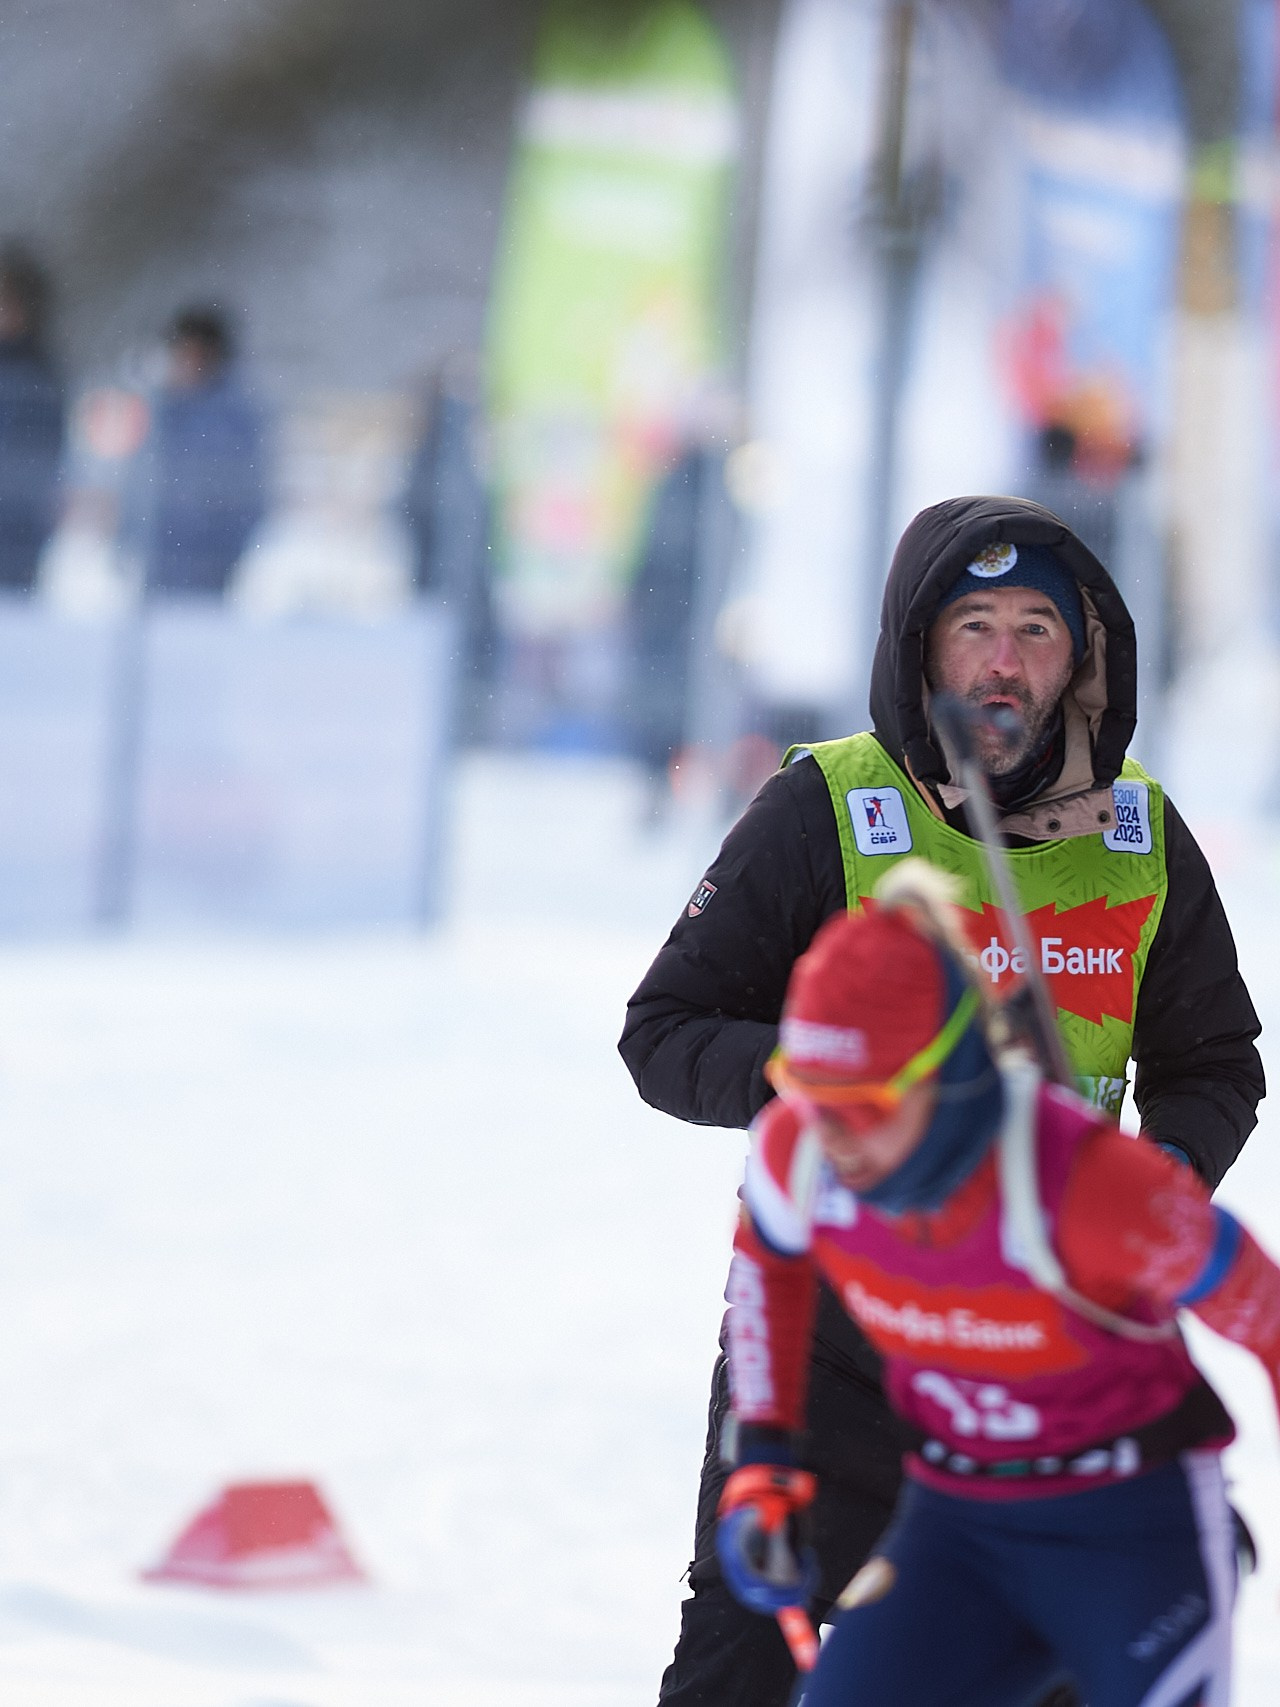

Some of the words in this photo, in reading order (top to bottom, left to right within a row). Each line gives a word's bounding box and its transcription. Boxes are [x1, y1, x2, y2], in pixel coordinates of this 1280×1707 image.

[1113, 789, 1138, 805] ЕЗОН
[1116, 805, 1140, 823] 024
[871, 836, 897, 844] СБР
[1113, 824, 1143, 843] 2025
[1041, 938, 1124, 974] Банк
